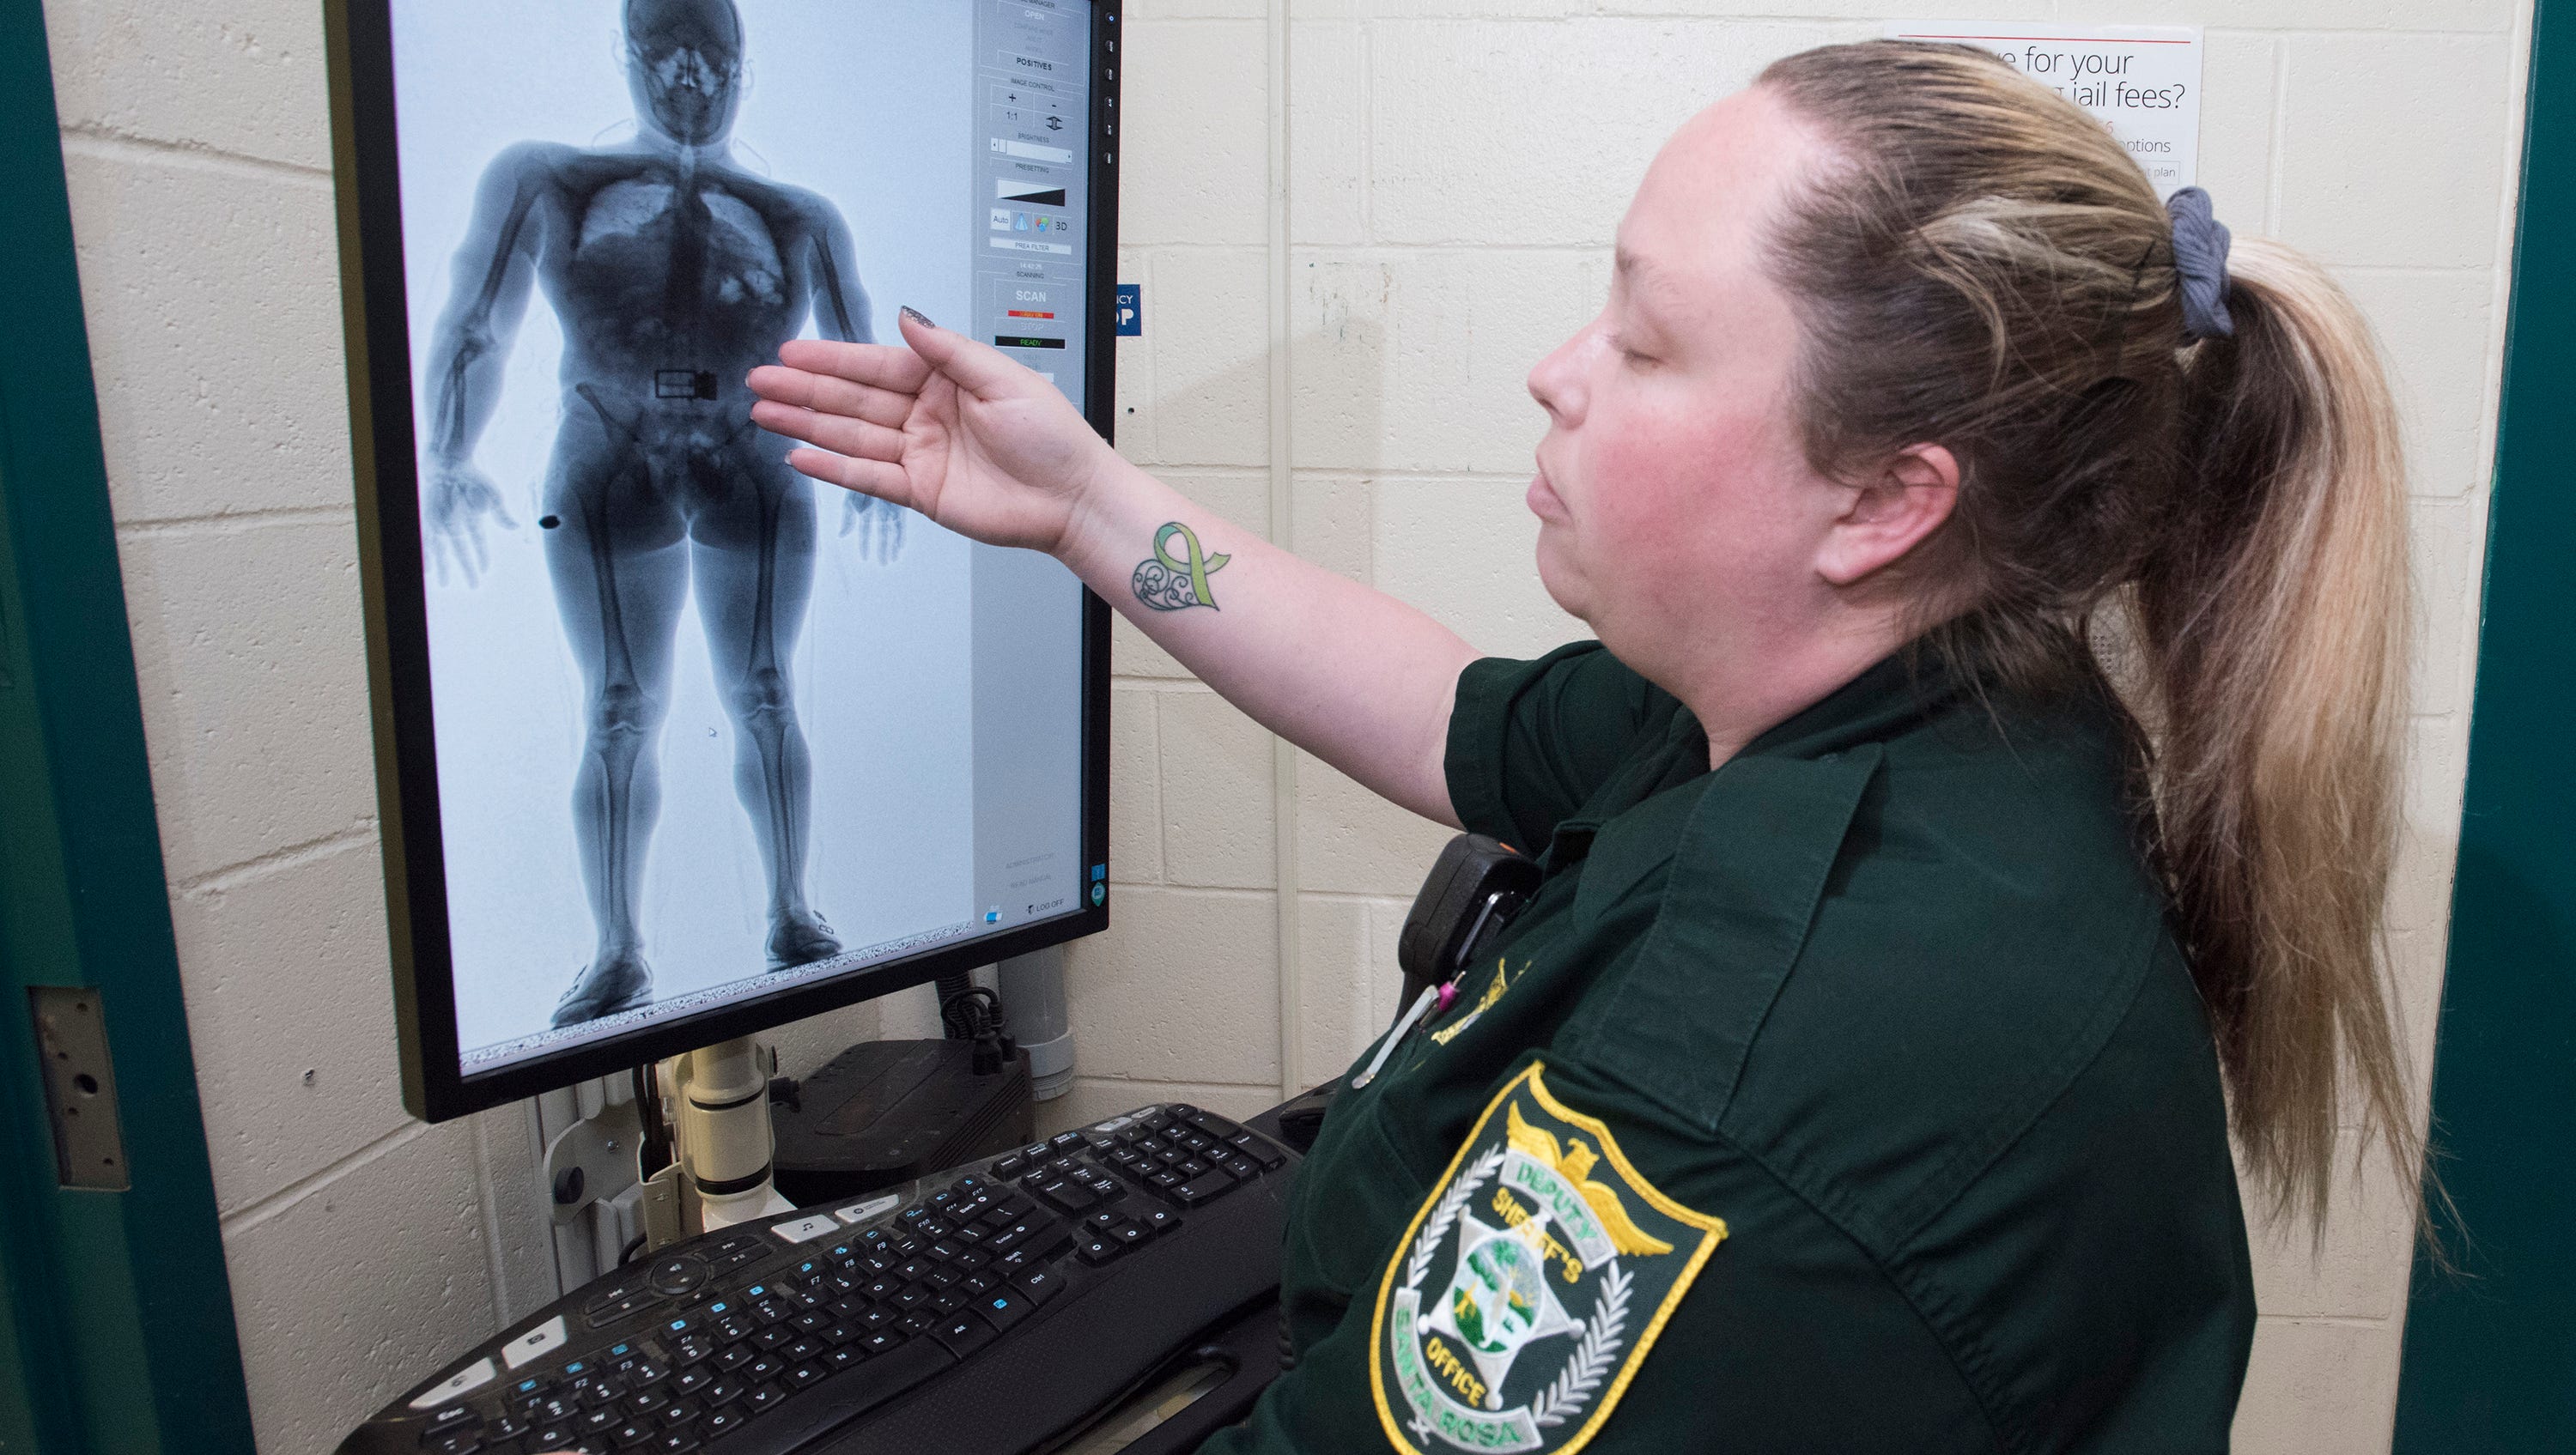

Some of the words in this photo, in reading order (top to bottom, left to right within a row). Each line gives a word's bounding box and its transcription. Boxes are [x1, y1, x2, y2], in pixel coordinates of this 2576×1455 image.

[1024, 10, 1045, 21] OPEN
[1016, 57, 1053, 71] POSITIVES
[2026, 45, 2064, 72] for
[2069, 53, 2134, 81] your
[1011, 77, 1027, 87] IMAGE
[1029, 81, 1055, 93] CONTROL
[2073, 81, 2106, 107] jail
[2115, 82, 2186, 109] fees?
[1006, 111, 1018, 121] 1:1
[1018, 132, 1050, 144] BRIGHTNESS
[1015, 162, 1049, 174] PRESETTING
[2154, 167, 2177, 179] plan
[993, 215, 1009, 225] Auto
[1055, 221, 1067, 231] 3D
[1031, 243, 1049, 252] FILTER
[1016, 270, 1045, 279] SCANNING
[1016, 290, 1047, 302] SCAN
[1116, 308, 1134, 325] P
[1019, 338, 1042, 347] READY
[1036, 901, 1050, 912] LOG
[1051, 898, 1065, 907] OFF
[1516, 1161, 1598, 1241] DEPUTY
[959, 1203, 977, 1214] Back
[995, 1234, 1013, 1244] Enter
[1030, 1274, 1045, 1284] Ctrl
[954, 1325, 967, 1334] Alt
[795, 1344, 806, 1353] H
[620, 1360, 634, 1371] F3
[1425, 1337, 1485, 1407] OFFICE
[574, 1378, 589, 1389] F2
[682, 1375, 694, 1385] R
[1395, 1309, 1434, 1417] SANTA
[1437, 1414, 1521, 1448] ROSA
[756, 1391, 766, 1401] V
[713, 1416, 726, 1425] C
[668, 1437, 681, 1447] X
